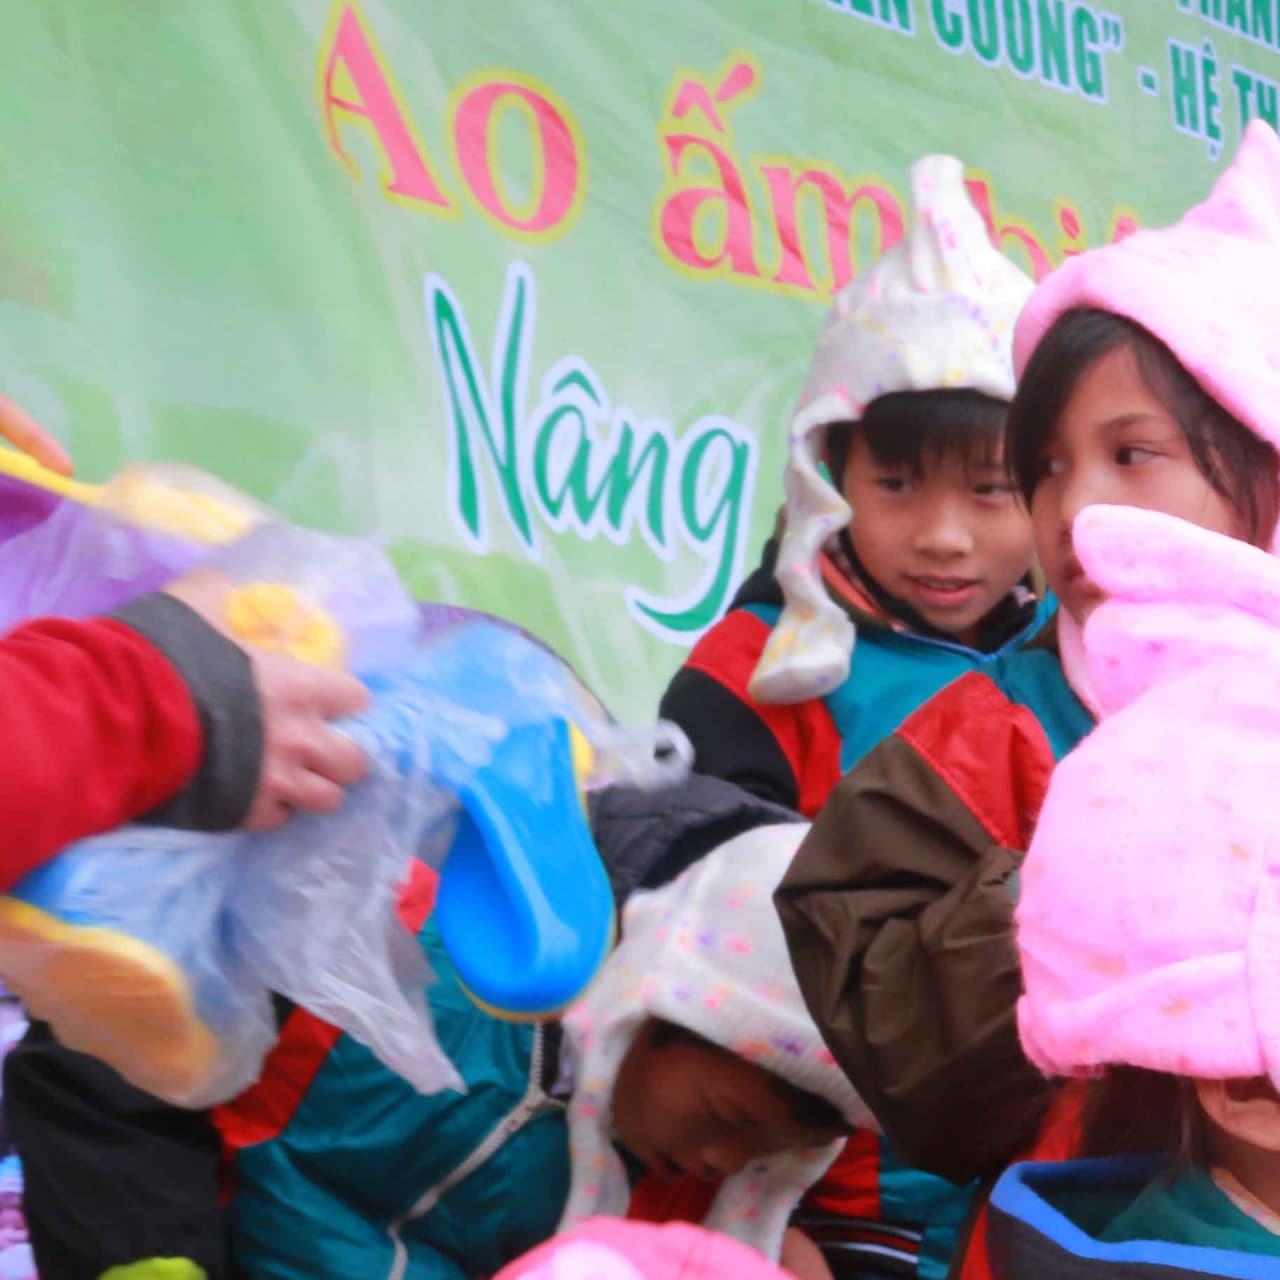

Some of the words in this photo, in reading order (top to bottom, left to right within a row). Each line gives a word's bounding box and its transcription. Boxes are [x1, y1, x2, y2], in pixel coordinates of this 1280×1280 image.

[660, 62, 906, 295] ấm
[1169, 38, 1222, 157] HỆ
[433, 273, 750, 633] Nâng
